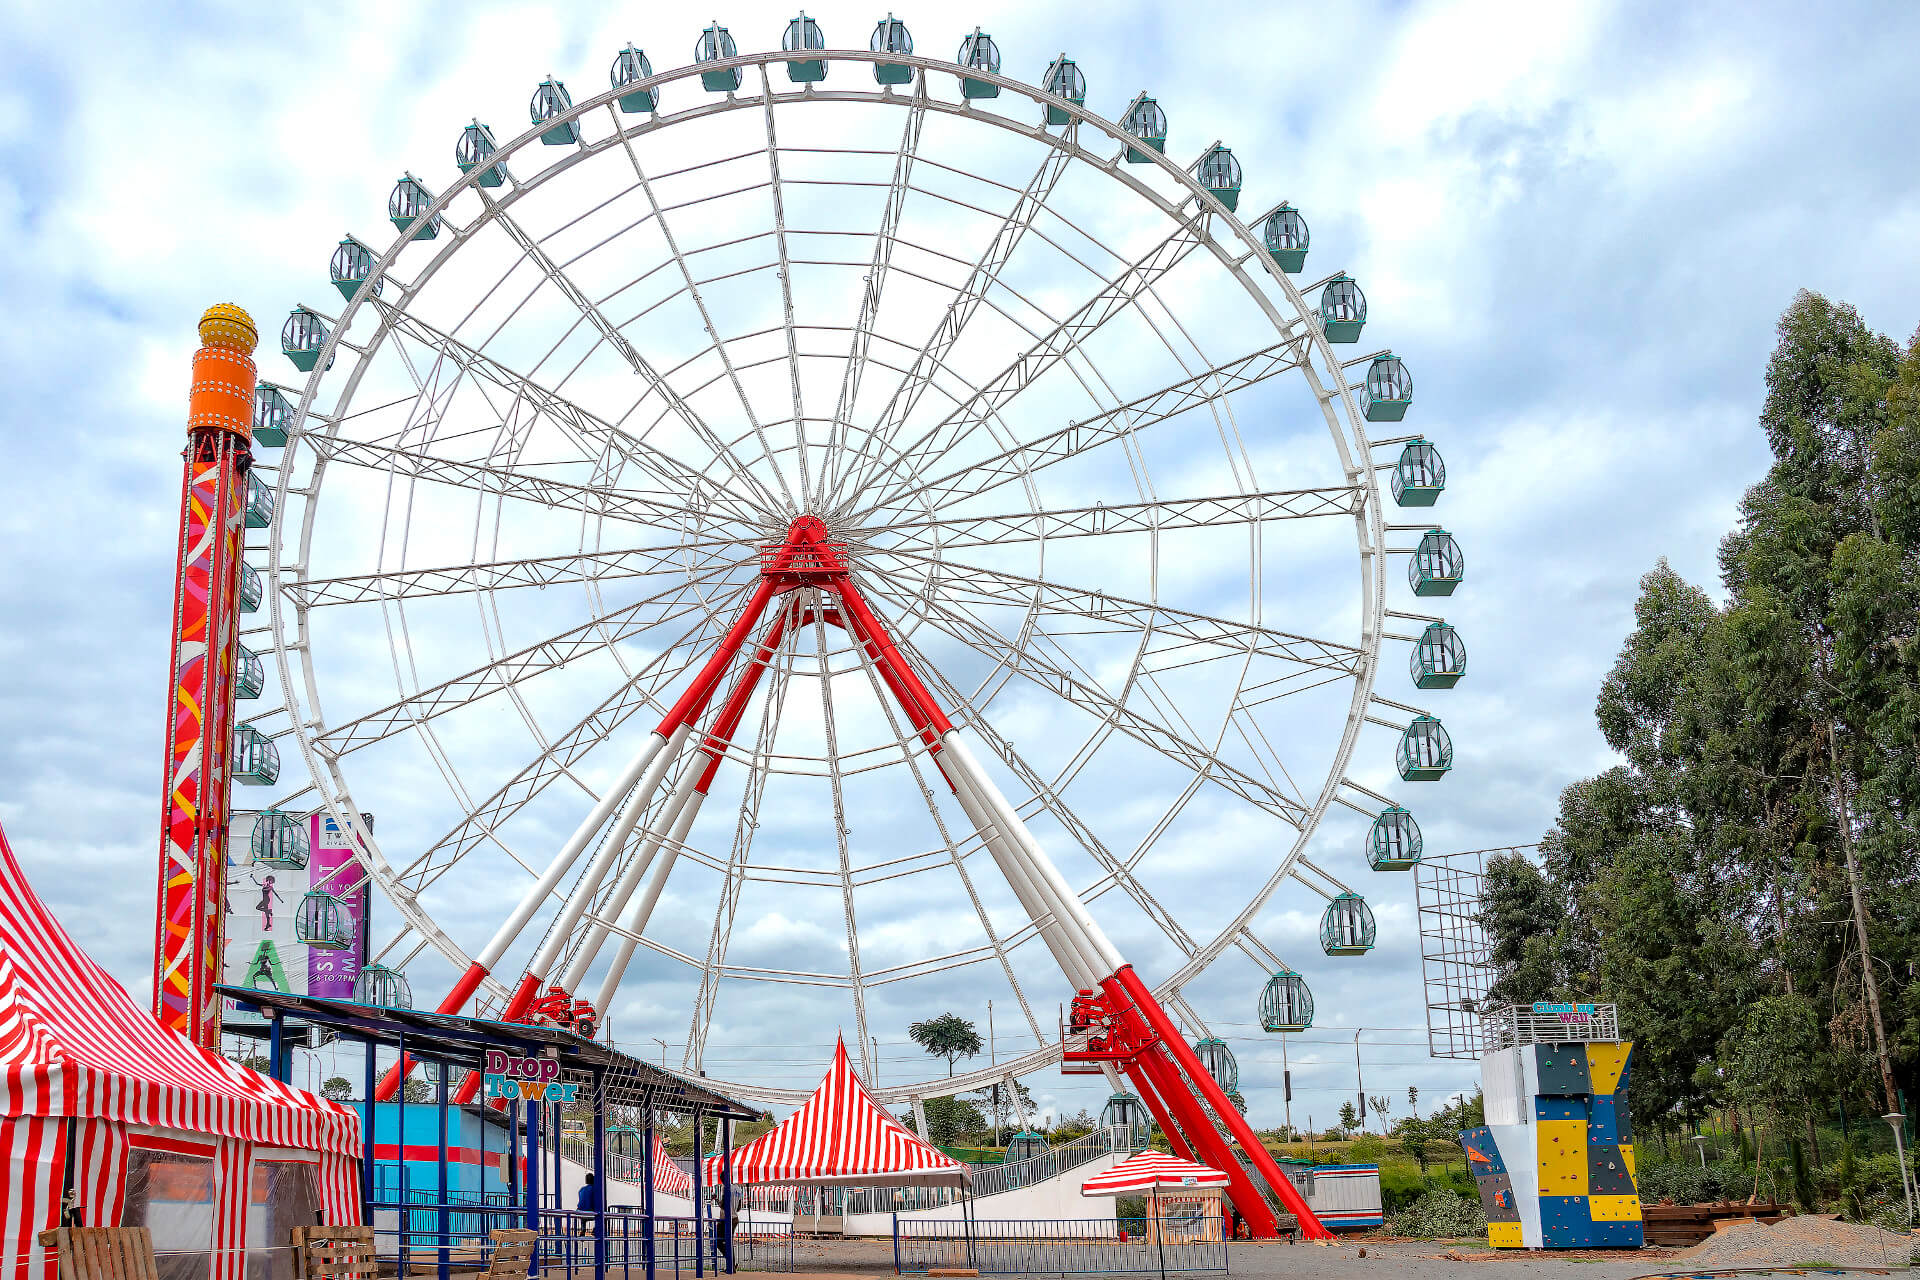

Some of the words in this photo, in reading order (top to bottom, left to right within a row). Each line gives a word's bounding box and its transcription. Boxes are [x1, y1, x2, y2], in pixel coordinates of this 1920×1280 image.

[323, 974, 335, 982] TO
[338, 974, 356, 982] 7PM
[1533, 1001, 1594, 1015] Climbing
[1558, 1012, 1588, 1024] Wall
[485, 1050, 560, 1083] Drop
[484, 1073, 579, 1103] Tower
